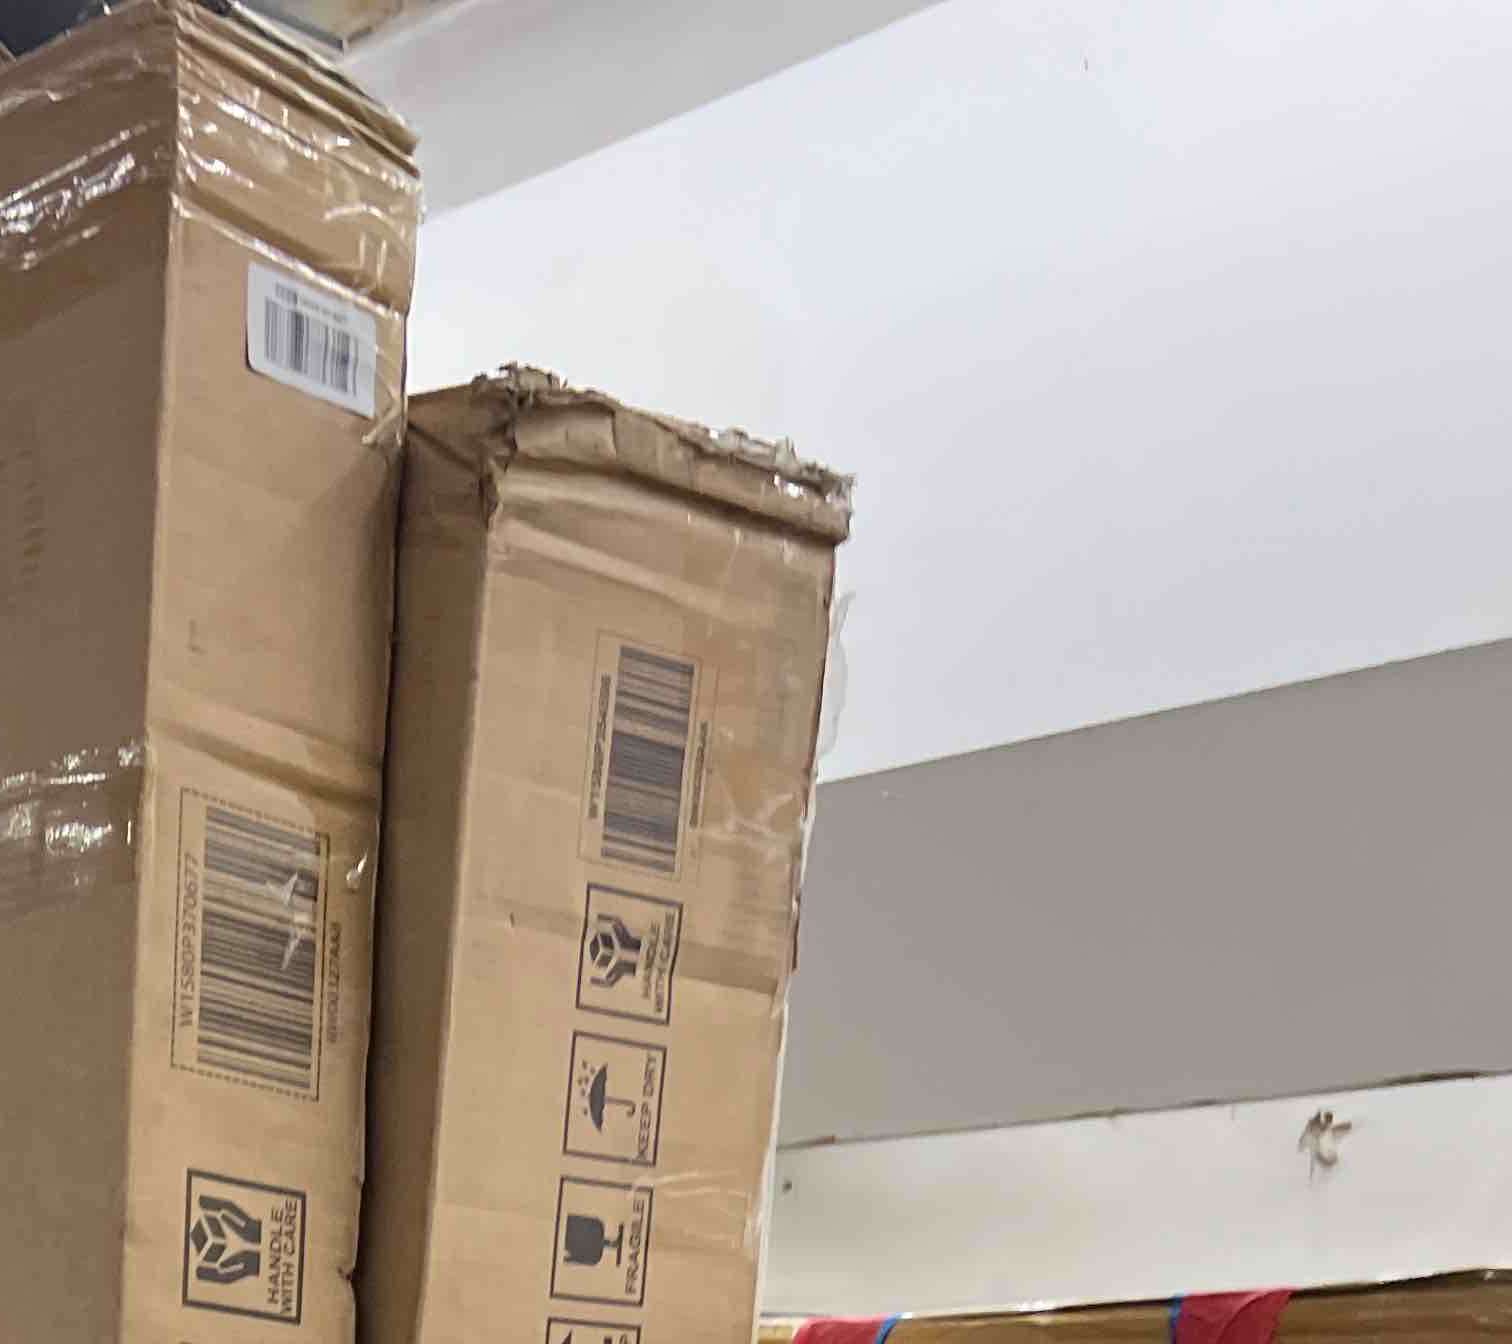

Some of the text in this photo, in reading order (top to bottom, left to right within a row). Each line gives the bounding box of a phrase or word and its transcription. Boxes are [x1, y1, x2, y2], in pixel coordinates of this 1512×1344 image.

[642, 1054, 657, 1097] DRY
[267, 1207, 284, 1305] HANDLE
[279, 1199, 298, 1315] WITH CARE
[625, 1199, 645, 1295] FRAGILE
